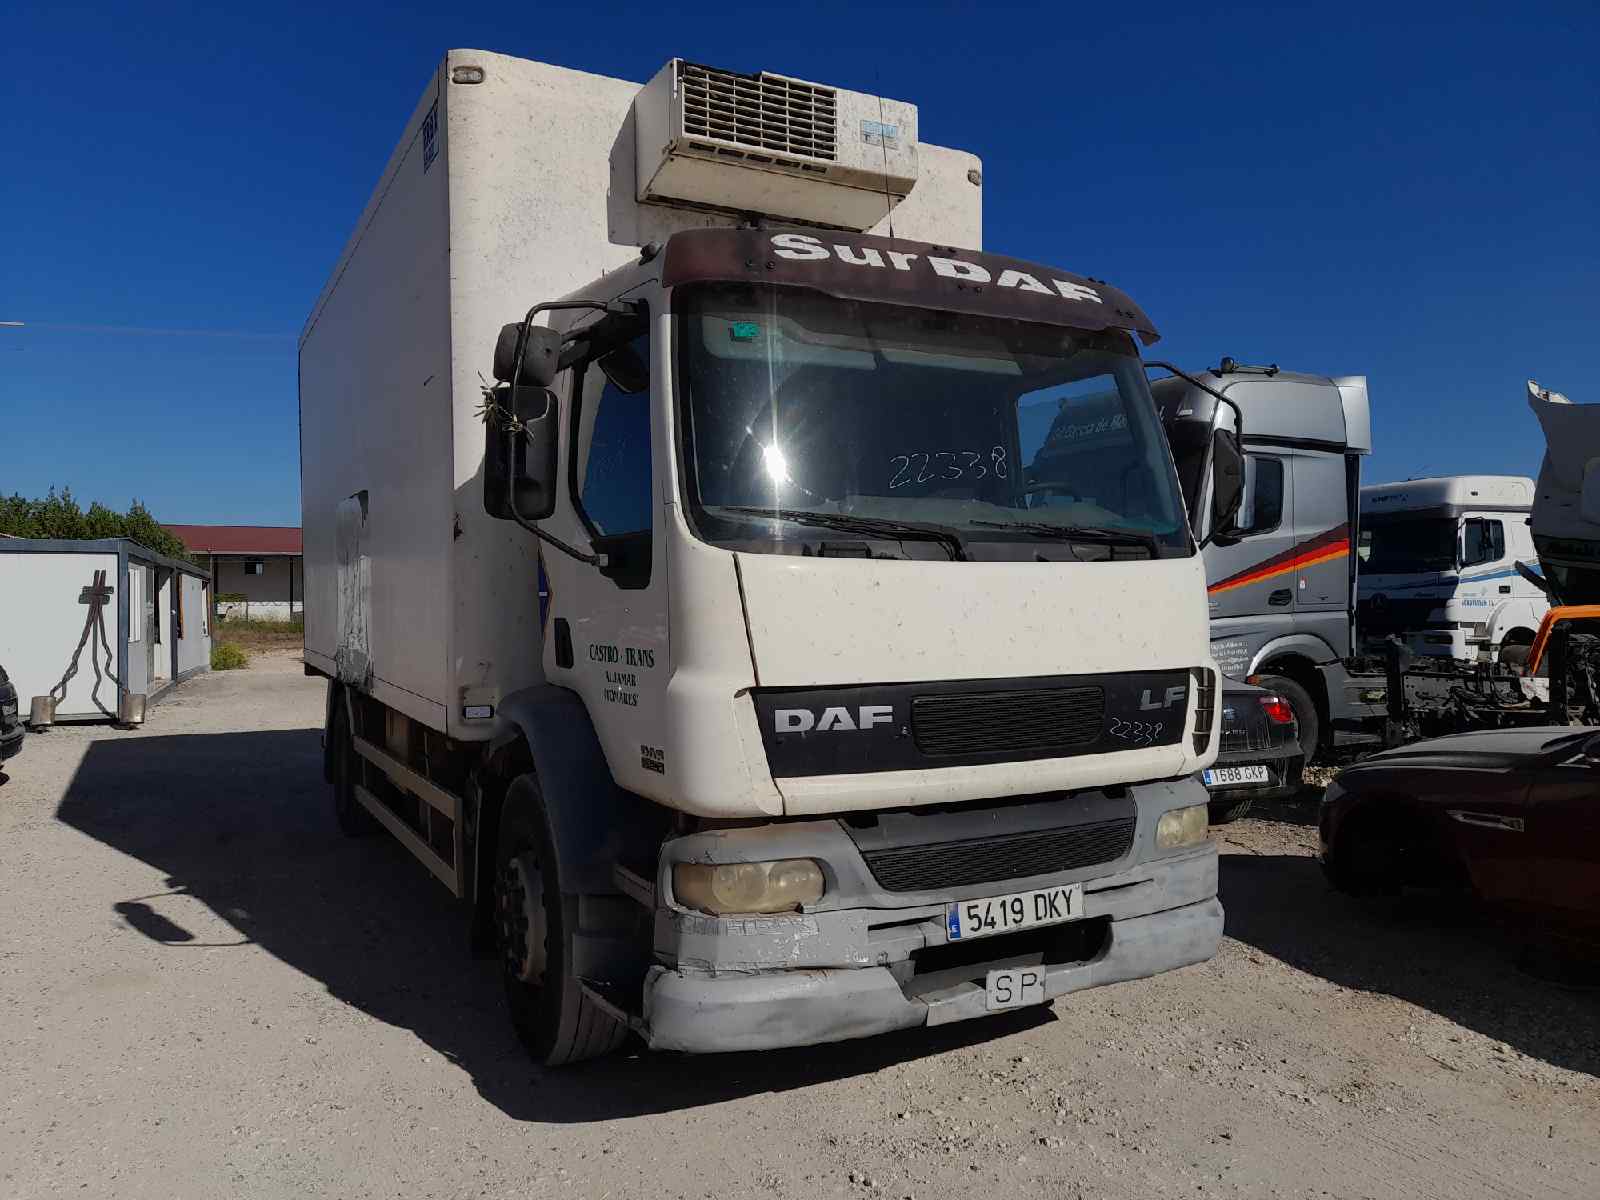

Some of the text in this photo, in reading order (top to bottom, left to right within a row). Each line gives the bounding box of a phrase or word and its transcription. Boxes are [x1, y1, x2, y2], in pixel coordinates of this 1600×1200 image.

[770, 233, 1103, 304] SurDAF
[890, 446, 1007, 489] 22338
[589, 643, 655, 668] CASTRO TRANS
[1140, 686, 1186, 711] LF
[775, 705, 893, 733] DAF
[967, 897, 1025, 932] 5419
[1034, 889, 1073, 921] DKY
